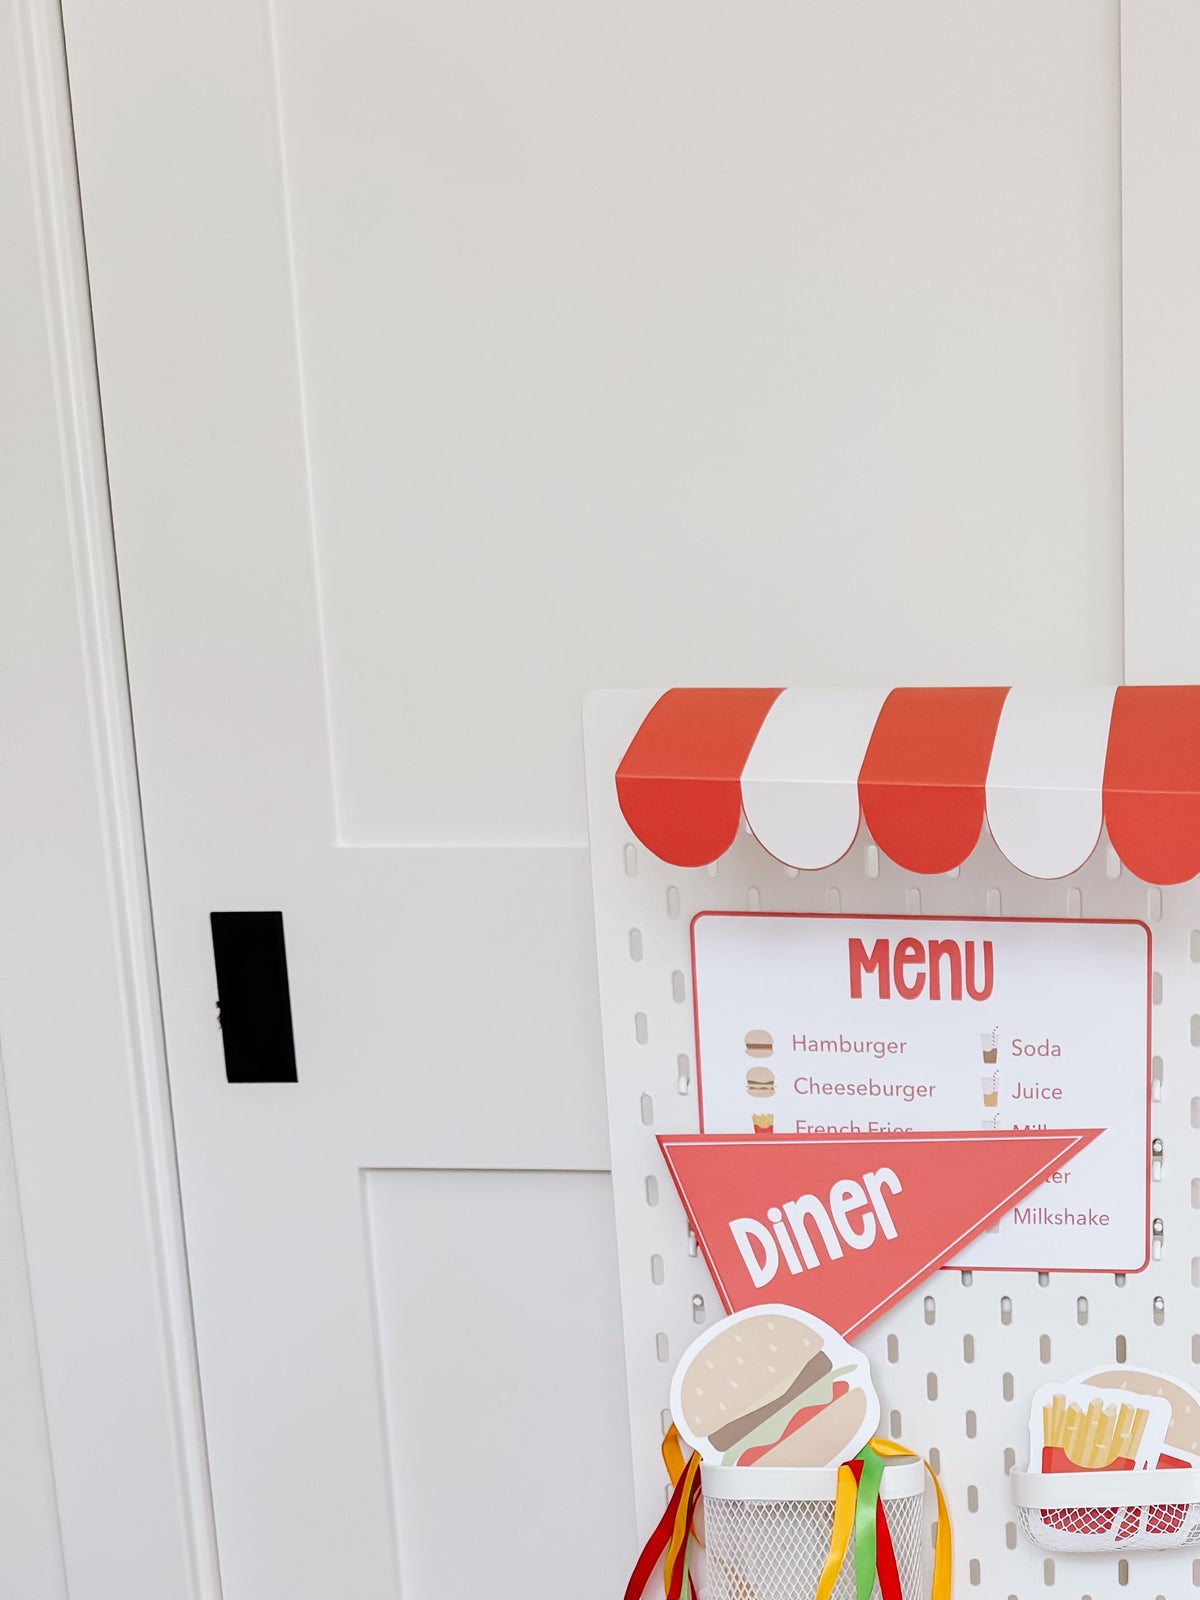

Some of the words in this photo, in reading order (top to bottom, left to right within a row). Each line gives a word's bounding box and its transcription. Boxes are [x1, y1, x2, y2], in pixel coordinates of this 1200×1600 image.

[792, 1034, 907, 1059] Hamburger
[1011, 1038, 1062, 1057] Soda
[793, 1076, 936, 1103] Cheeseburger
[1012, 1081, 1063, 1100] Juice
[729, 1167, 903, 1288] Diner
[1013, 1207, 1110, 1226] Milkshake
